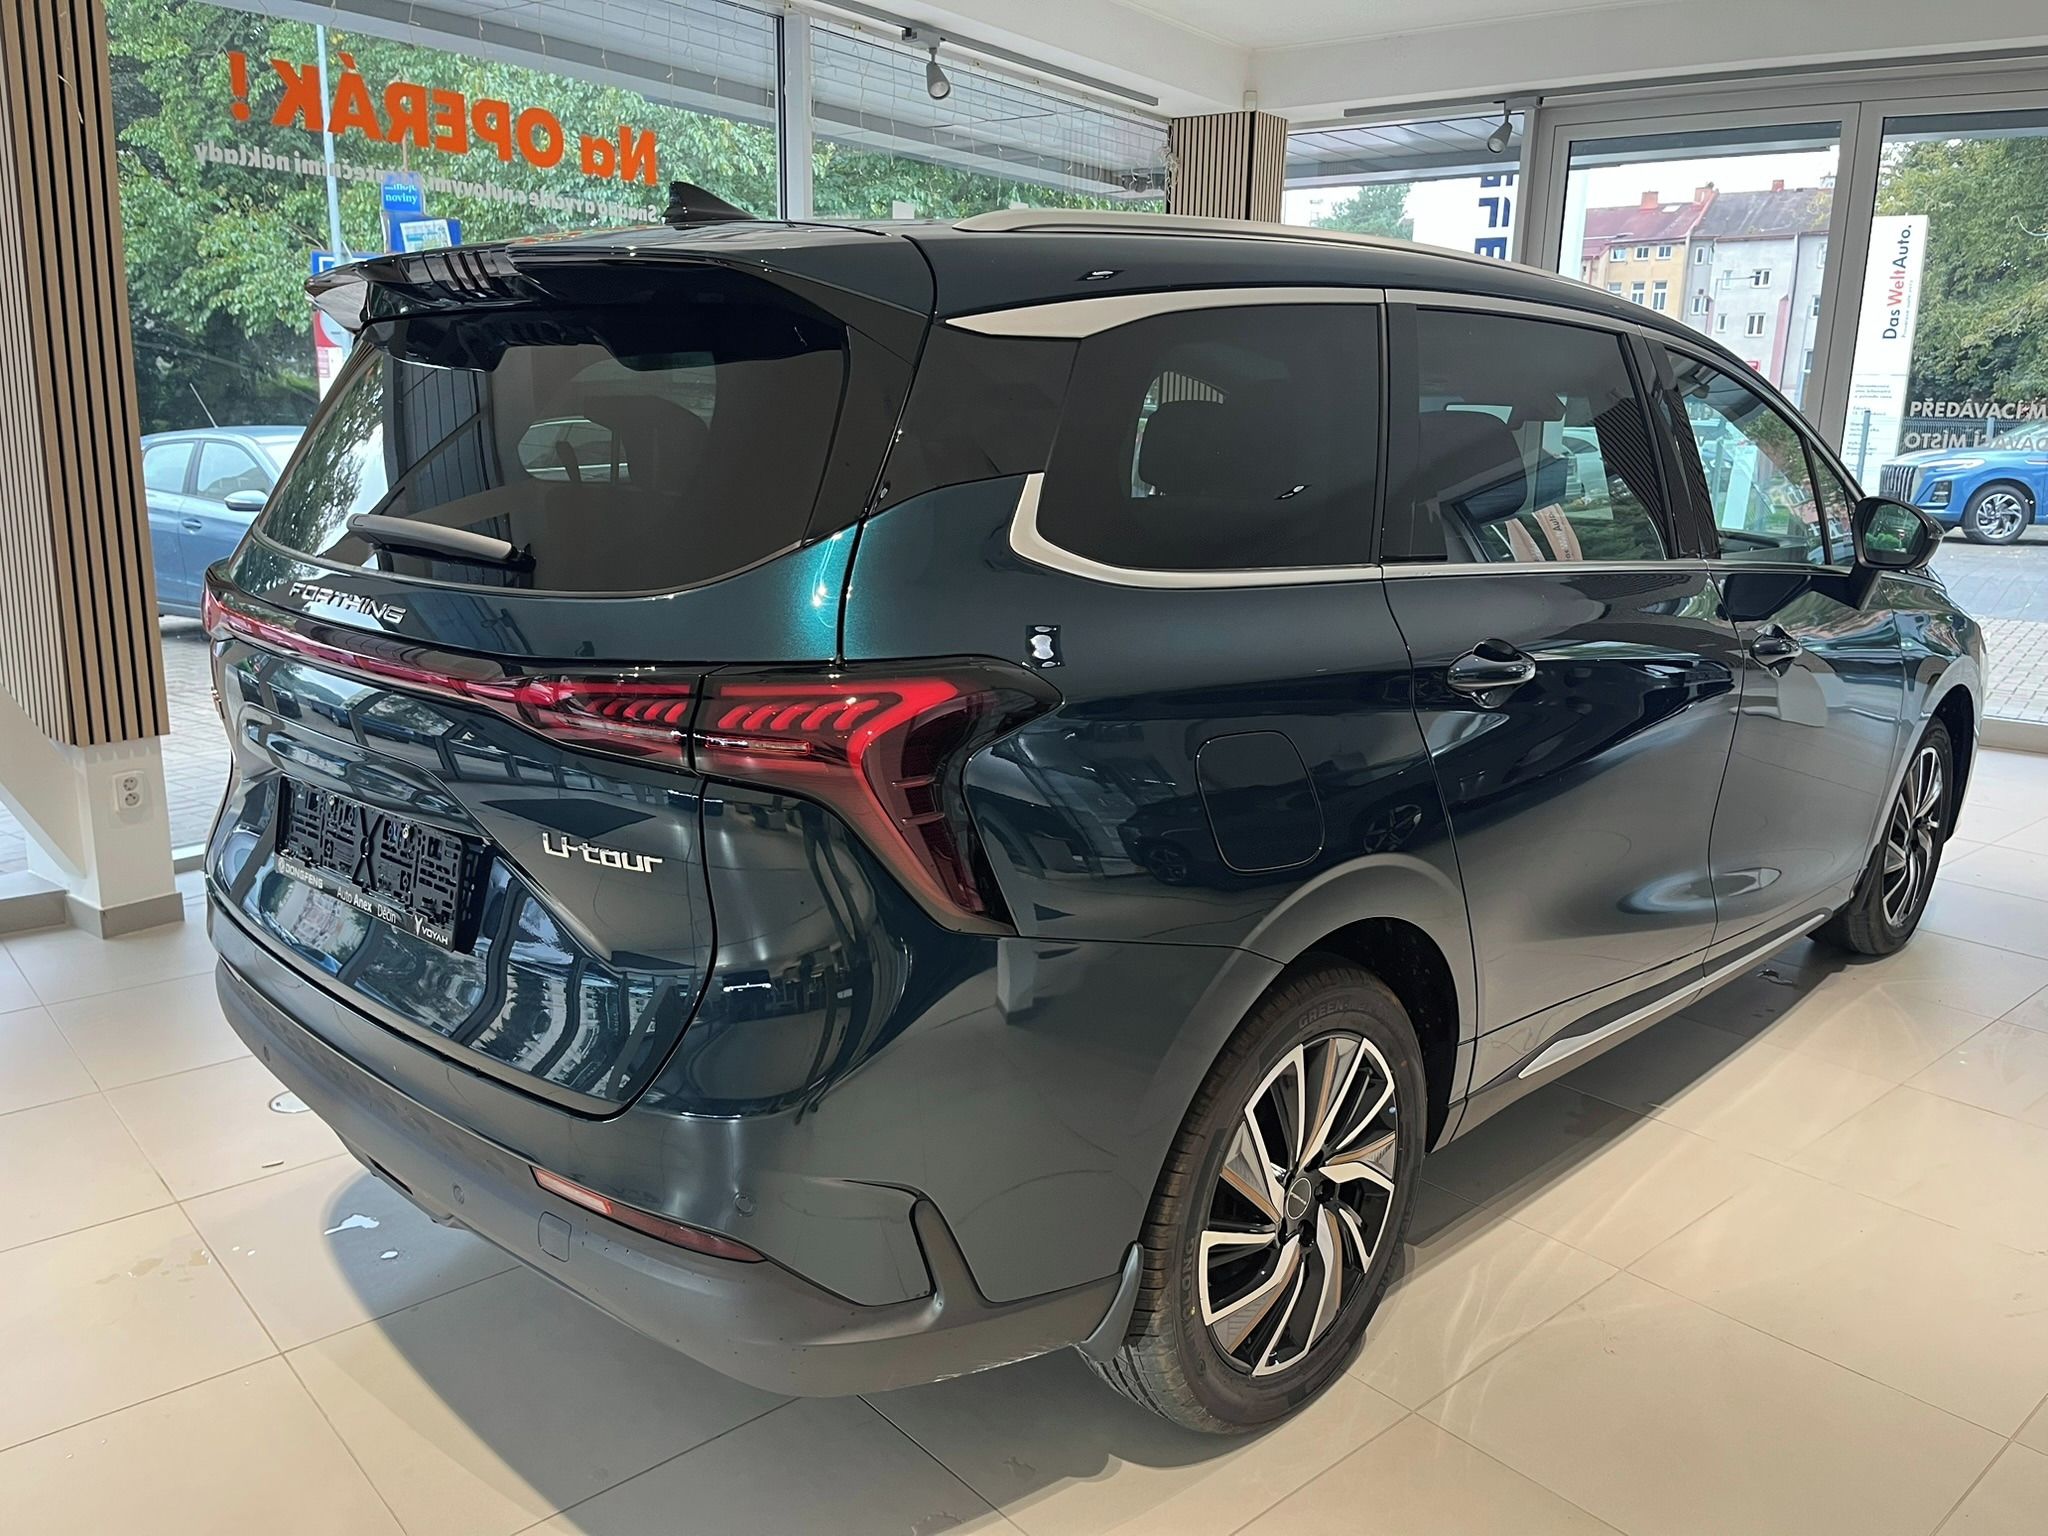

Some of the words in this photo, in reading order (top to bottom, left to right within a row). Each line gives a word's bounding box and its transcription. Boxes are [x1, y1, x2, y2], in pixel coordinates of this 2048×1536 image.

[385, 192, 418, 205] noviny
[1882, 309, 1901, 340] Das
[288, 582, 407, 624] FORTHING
[284, 863, 324, 889] DONGFENG
[336, 886, 352, 903] Auto
[353, 894, 373, 913] Anex
[421, 926, 449, 945] VOYAH
